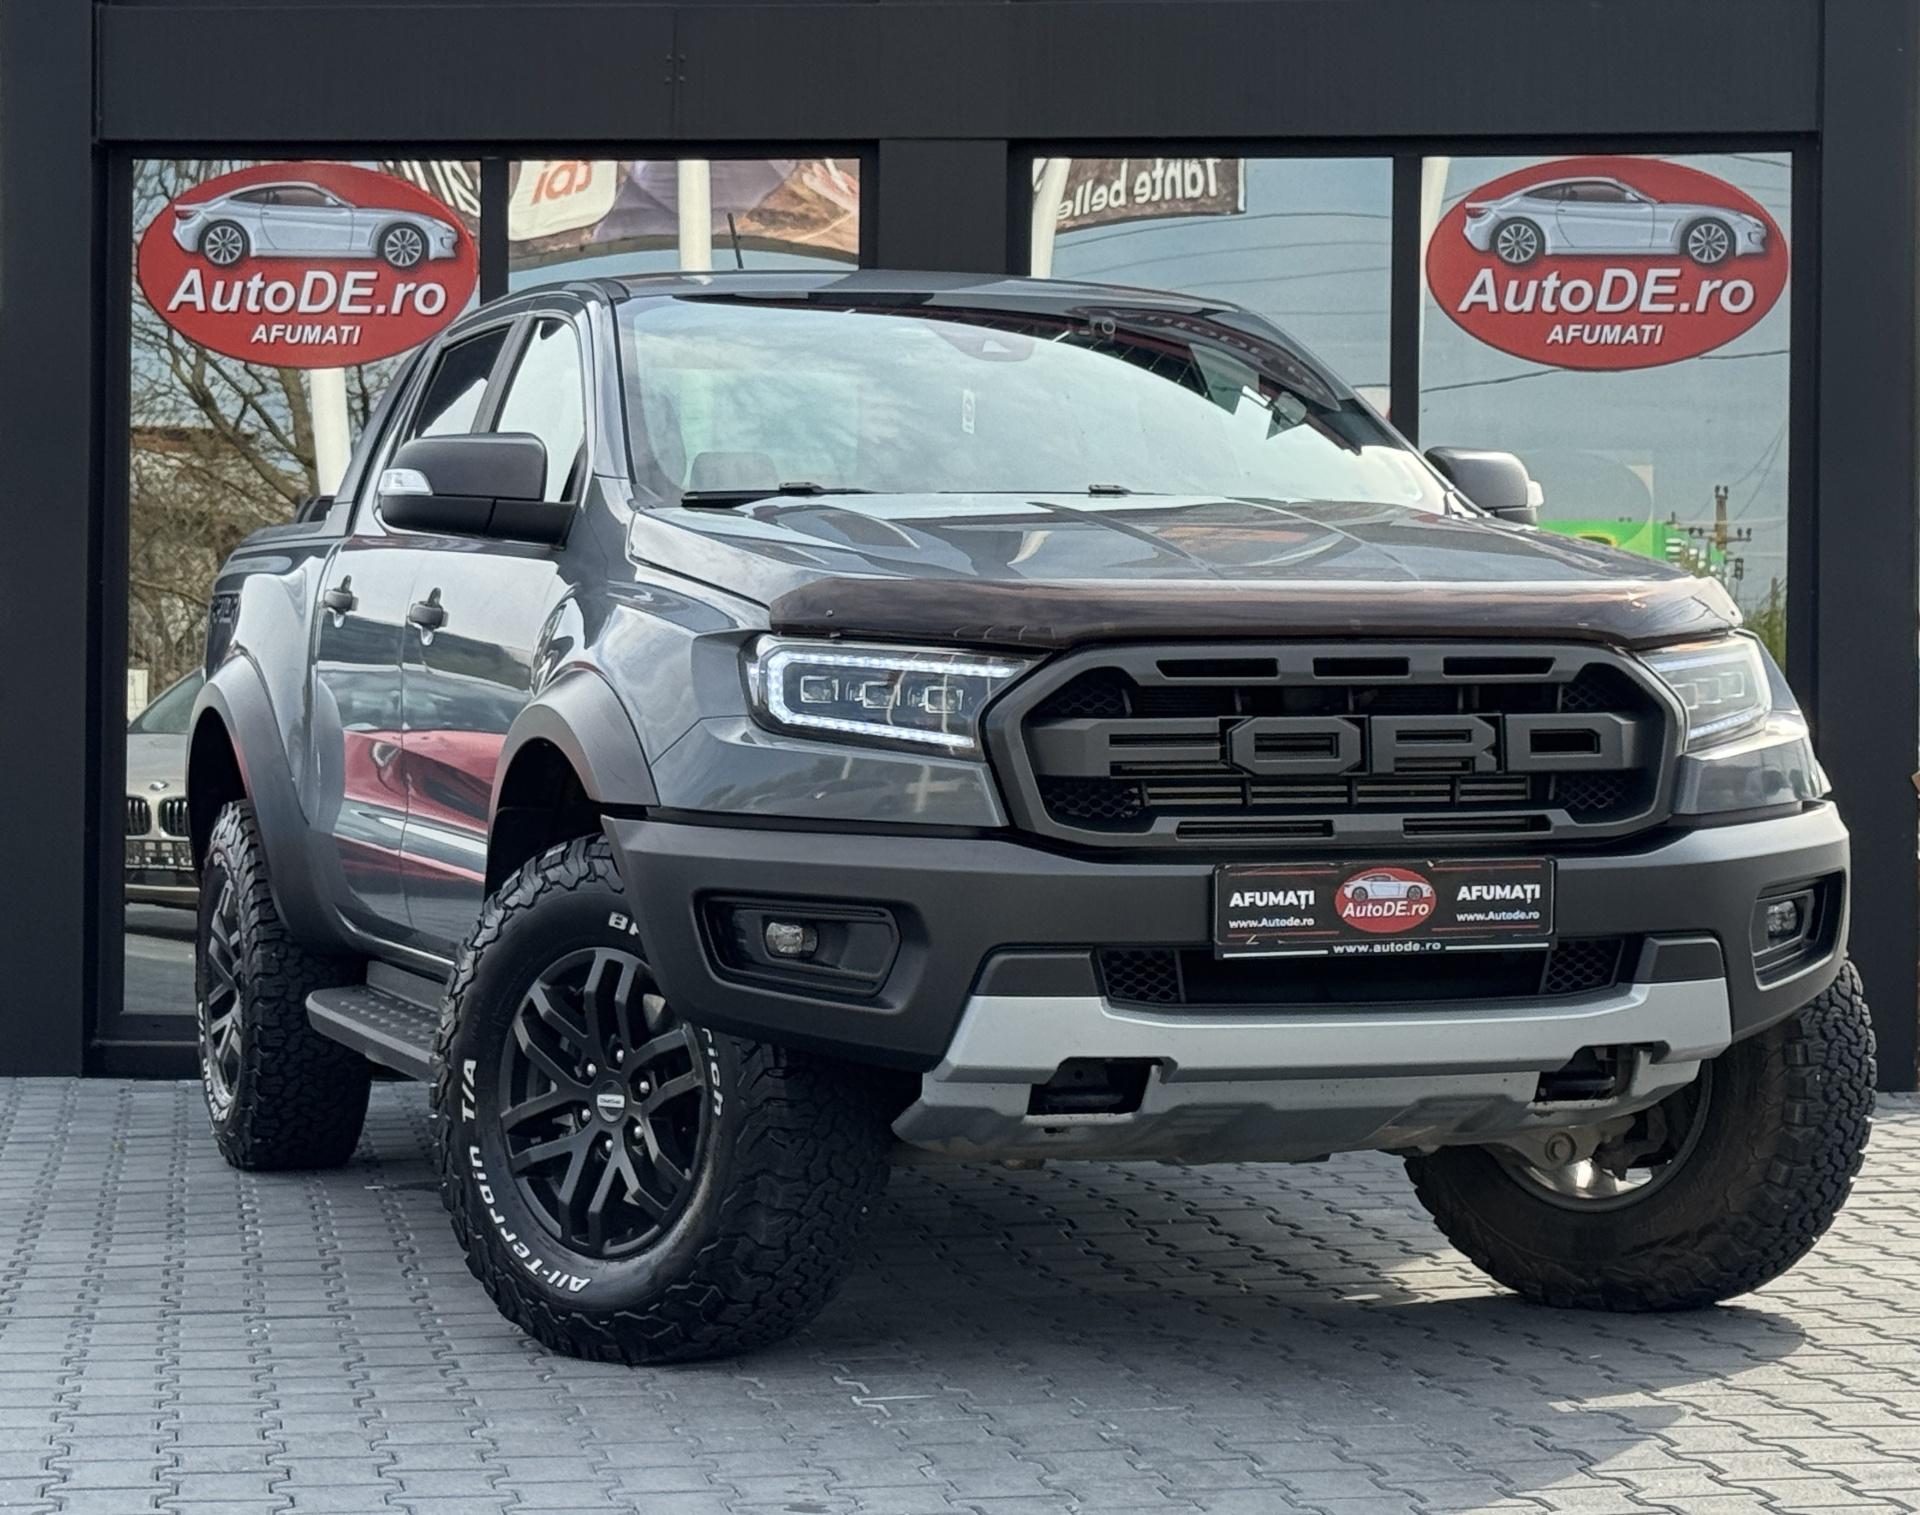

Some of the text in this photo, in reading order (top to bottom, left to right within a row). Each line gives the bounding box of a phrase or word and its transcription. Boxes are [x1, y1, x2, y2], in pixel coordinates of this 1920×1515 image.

[167, 268, 447, 316] AutoDE.ro
[1457, 267, 1755, 315] AutoDE.ro
[251, 324, 362, 346] AFUMATI
[1546, 323, 1664, 346] AFUMATI
[1030, 712, 1642, 778] FORD
[1342, 900, 1430, 919] AutoDE.ro
[1456, 910, 1541, 922] www.Autode.ro
[1228, 916, 1315, 929] www.Autode.ro
[1333, 940, 1442, 954] www.autode.ro
[461, 1058, 592, 1294] All-Terrain T/A
